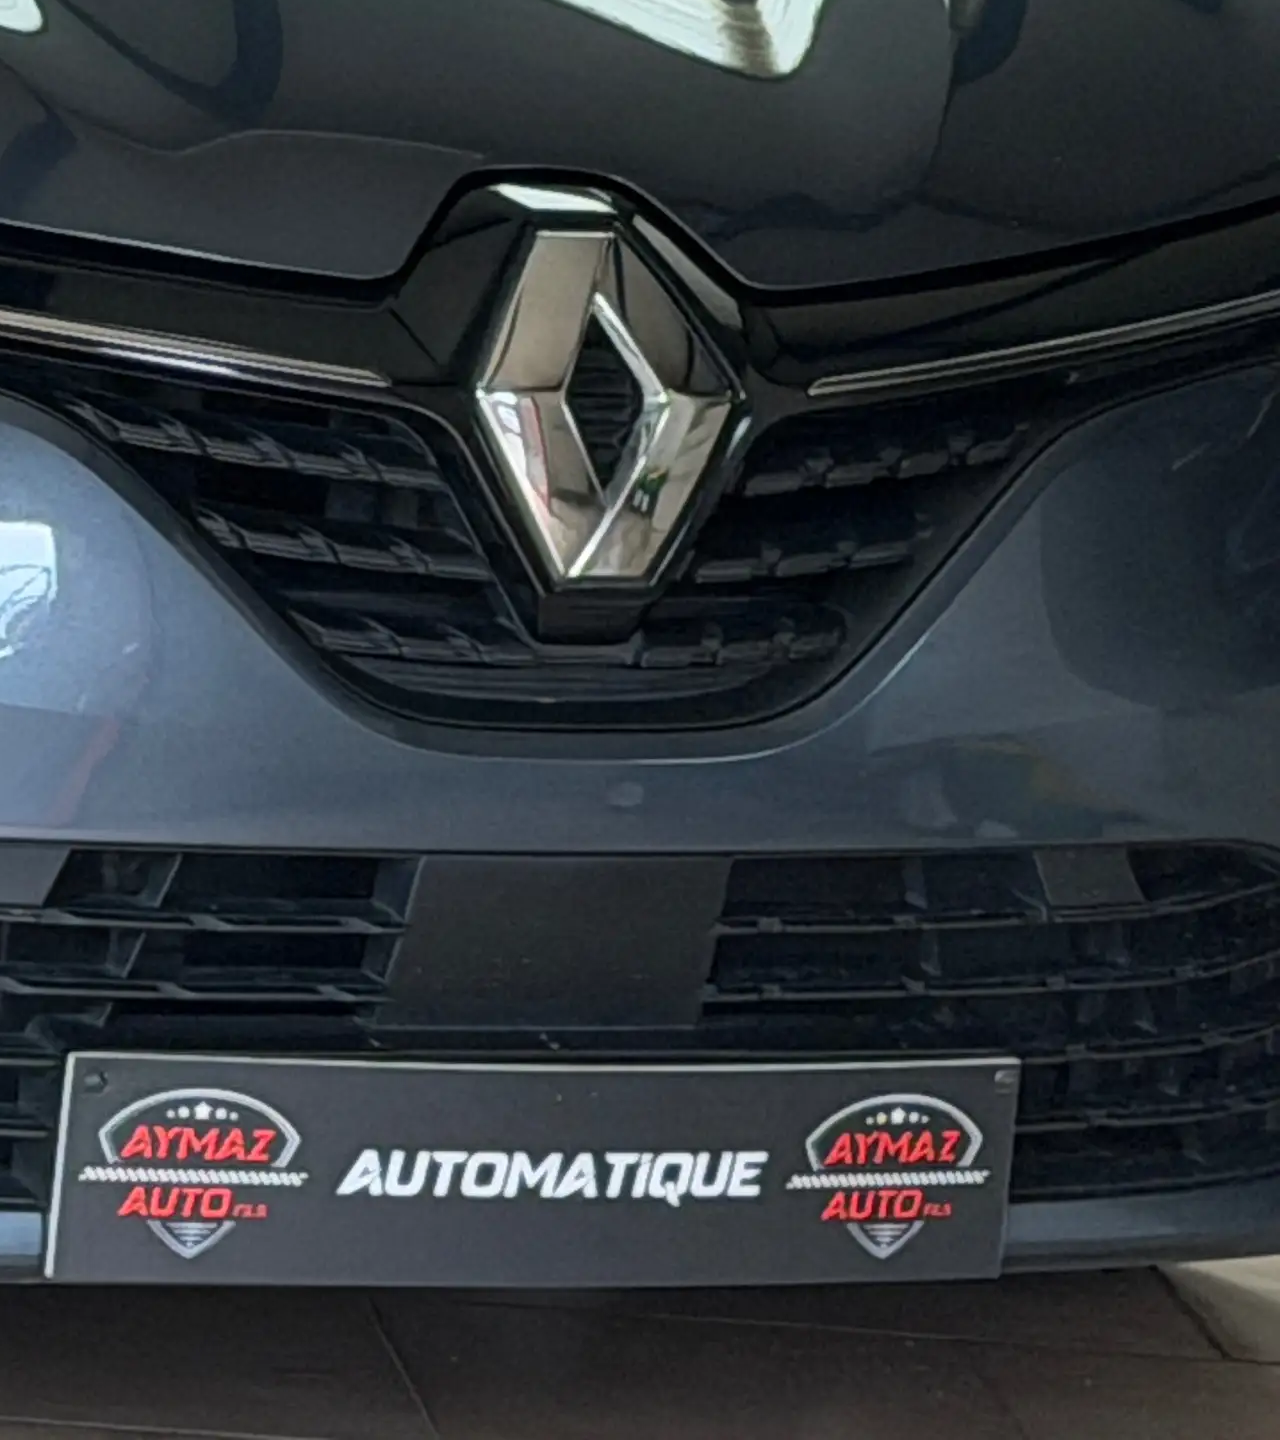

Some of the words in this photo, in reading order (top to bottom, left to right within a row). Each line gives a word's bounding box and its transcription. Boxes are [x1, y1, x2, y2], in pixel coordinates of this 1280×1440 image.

[120, 1124, 277, 1163] AYMAZ
[823, 1129, 961, 1166] AYMAZ
[336, 1148, 769, 1208] AUTOMATIQUE
[117, 1186, 233, 1219] AUTO
[820, 1189, 924, 1221] AUTO
